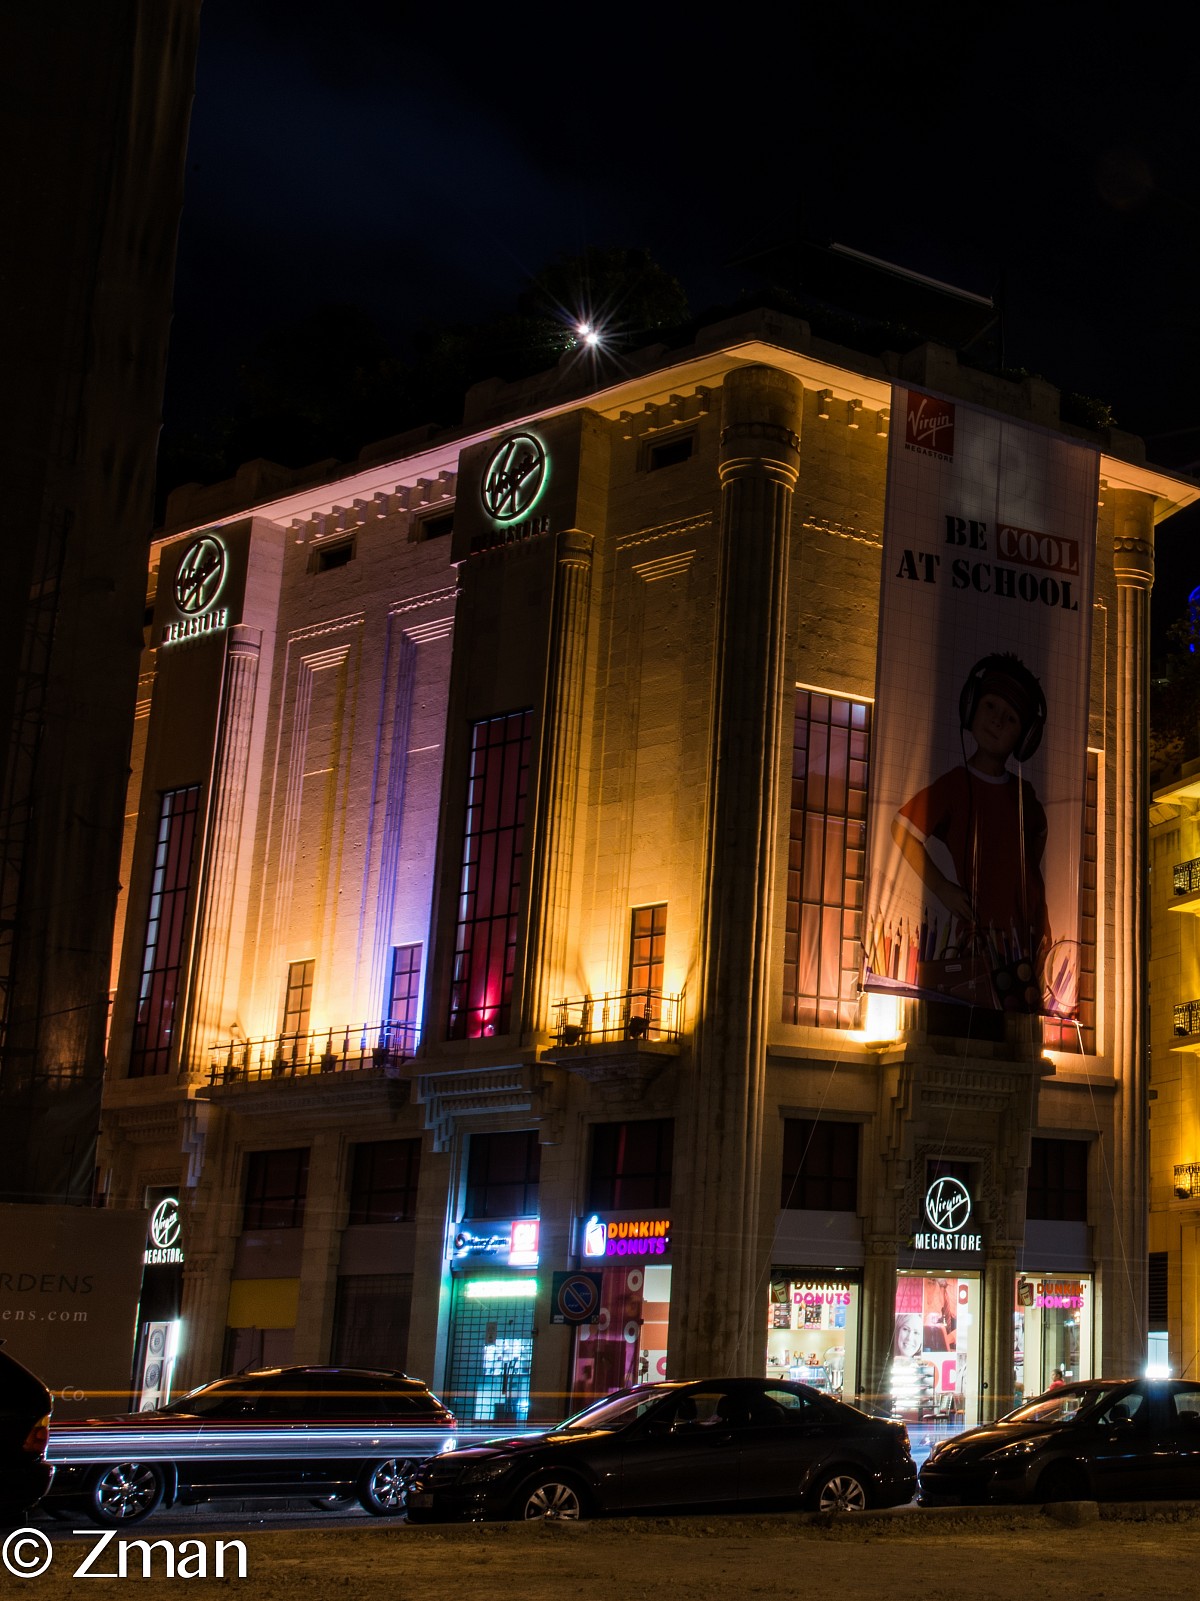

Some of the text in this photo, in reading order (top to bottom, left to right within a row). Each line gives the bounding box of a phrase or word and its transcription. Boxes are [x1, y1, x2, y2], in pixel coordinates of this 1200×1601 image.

[908, 398, 953, 446] Virgin
[904, 442, 954, 464] MEGASTORE
[945, 514, 1078, 572] BE COOL
[896, 549, 1078, 611] AT SCHOOL
[162, 608, 228, 645] MEGASTORE
[930, 1181, 969, 1228] Virgin
[607, 1220, 670, 1239] DUNKIN'
[606, 1237, 666, 1256] DONUTS
[915, 1233, 982, 1251] MEGASTORE
[793, 1291, 851, 1306] DONUTS
[1035, 1295, 1084, 1309] DONUTS
